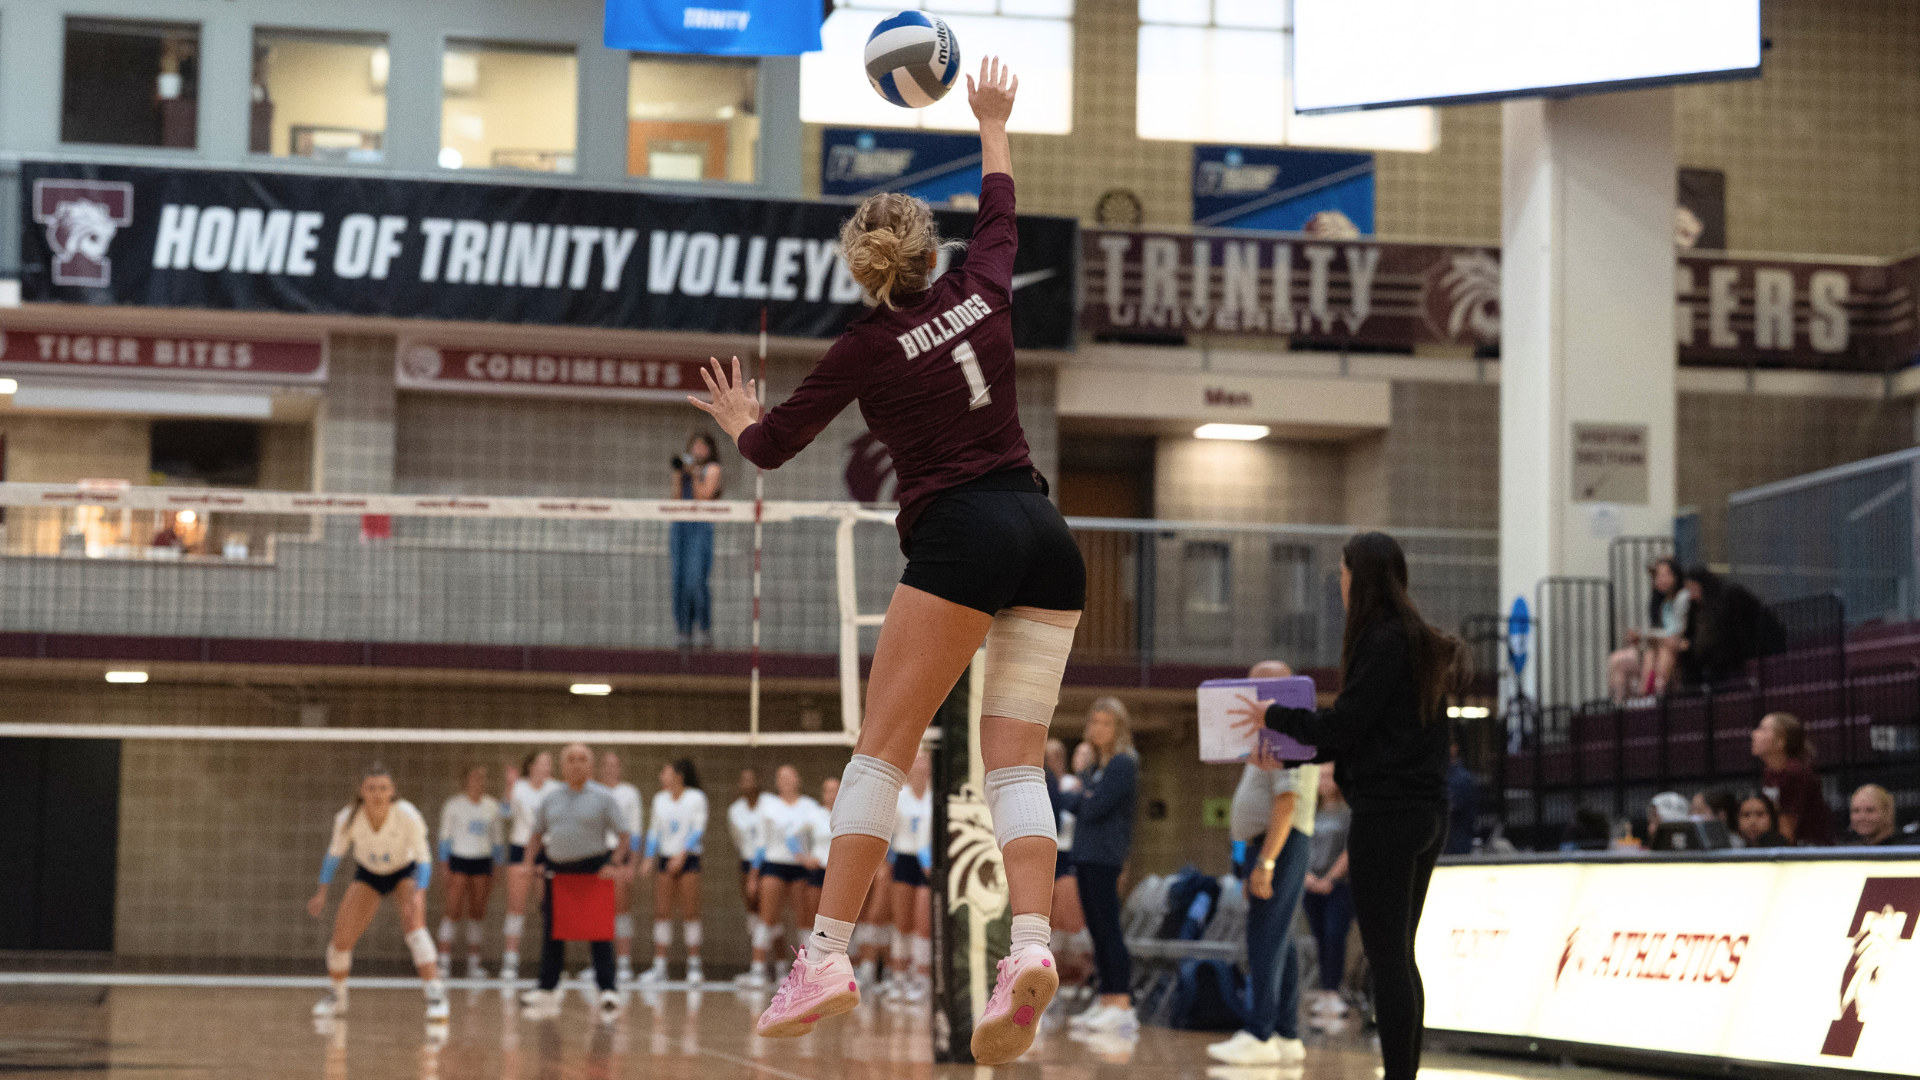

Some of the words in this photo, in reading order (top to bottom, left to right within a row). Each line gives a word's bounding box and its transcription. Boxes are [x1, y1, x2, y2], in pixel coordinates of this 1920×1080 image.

[153, 203, 324, 277] HOME
[333, 213, 406, 281] OF
[419, 216, 636, 292] TRINITY
[1098, 235, 1380, 318] TRINITY
[36, 335, 140, 363] TIGER
[153, 340, 253, 368] BITES
[897, 293, 993, 361] BULLDOGS
[465, 353, 682, 387] CONDIMENTS
[950, 339, 993, 412] 1
[1592, 932, 1750, 984] ATHLETICS
